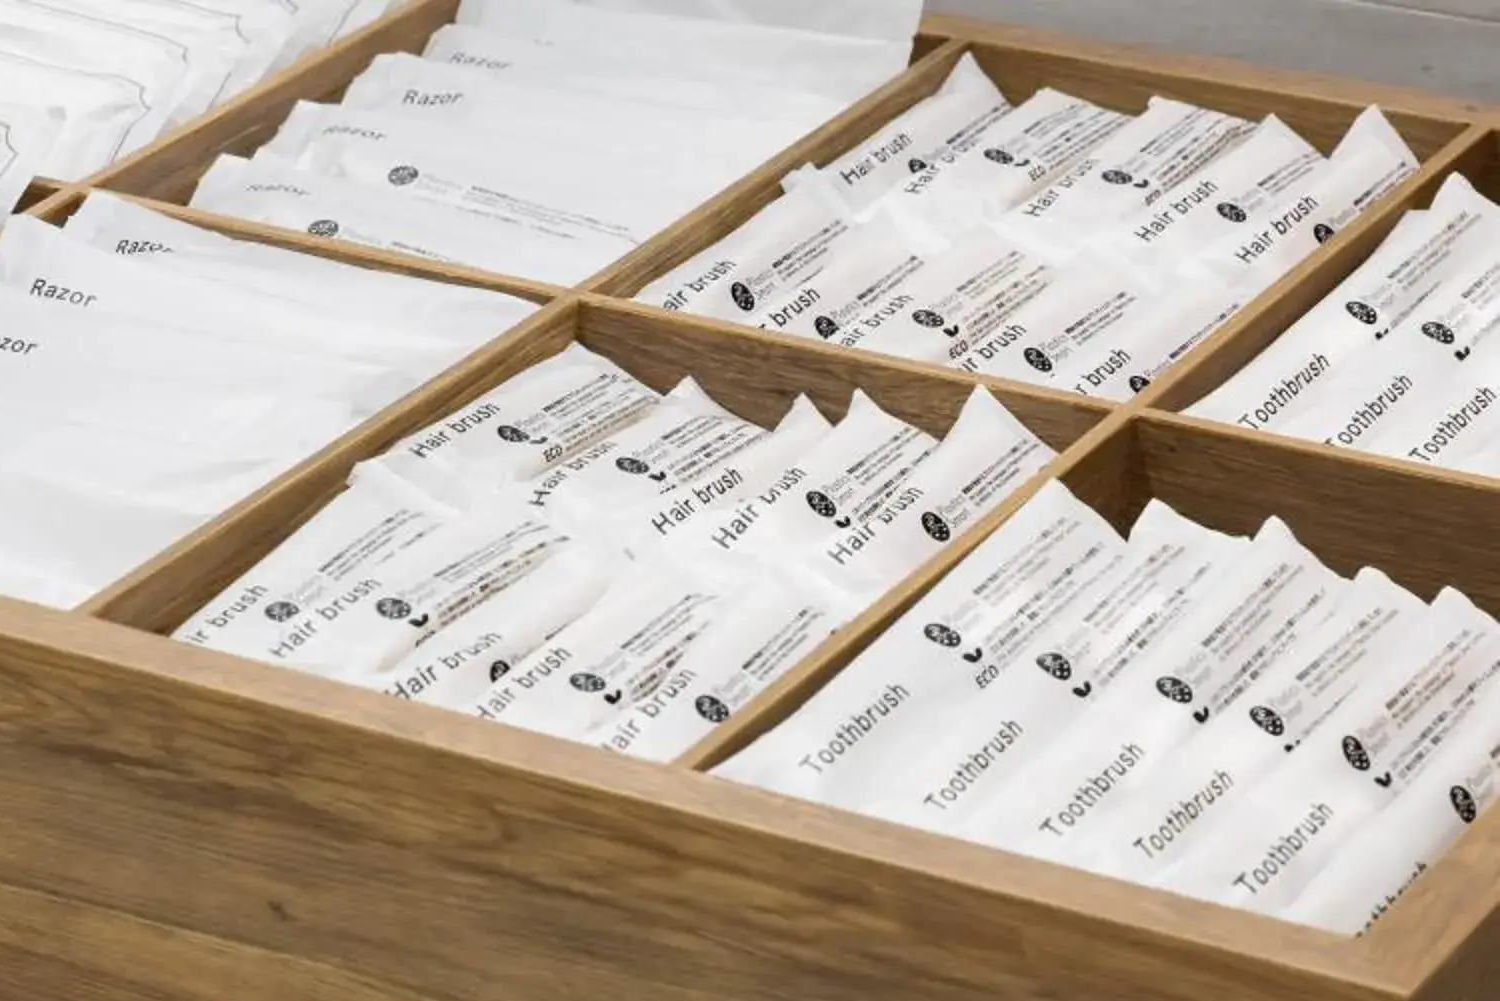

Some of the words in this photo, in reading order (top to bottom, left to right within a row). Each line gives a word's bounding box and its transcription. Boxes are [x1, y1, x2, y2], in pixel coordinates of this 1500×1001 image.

[450, 51, 514, 71] Razor
[403, 89, 463, 107] Razor
[1022, 188, 1061, 217] Hair
[1134, 208, 1176, 243] Hair
[1172, 177, 1220, 215] brush
[1234, 229, 1276, 264] Hair
[1269, 192, 1321, 236] brush
[30, 278, 97, 309] Razor
[663, 290, 688, 310] air
[684, 258, 737, 293] brush
[769, 286, 822, 327] brush
[862, 293, 915, 328] brush
[976, 322, 1028, 361] brush
[1081, 348, 1132, 387] brush
[1237, 352, 1332, 431] Toothbrush
[408, 431, 452, 459] Hair
[447, 402, 502, 433] brush
[1408, 384, 1498, 463] Toothbrush
[651, 498, 695, 536] Hair
[692, 467, 744, 505] brush
[711, 502, 760, 550] Hair
[827, 523, 876, 565] Hair
[208, 583, 269, 628] brush
[268, 619, 318, 658] Hair
[314, 577, 383, 621] brush
[437, 631, 503, 670] brush
[515, 646, 574, 690] brush
[600, 718, 643, 750] air
[798, 682, 911, 775] Toothbrush
[923, 718, 1025, 811] Toothbrush
[1038, 740, 1146, 838] Toothbrush
[1132, 769, 1235, 859] Toothbrush
[1231, 801, 1335, 895] Toothbrush
